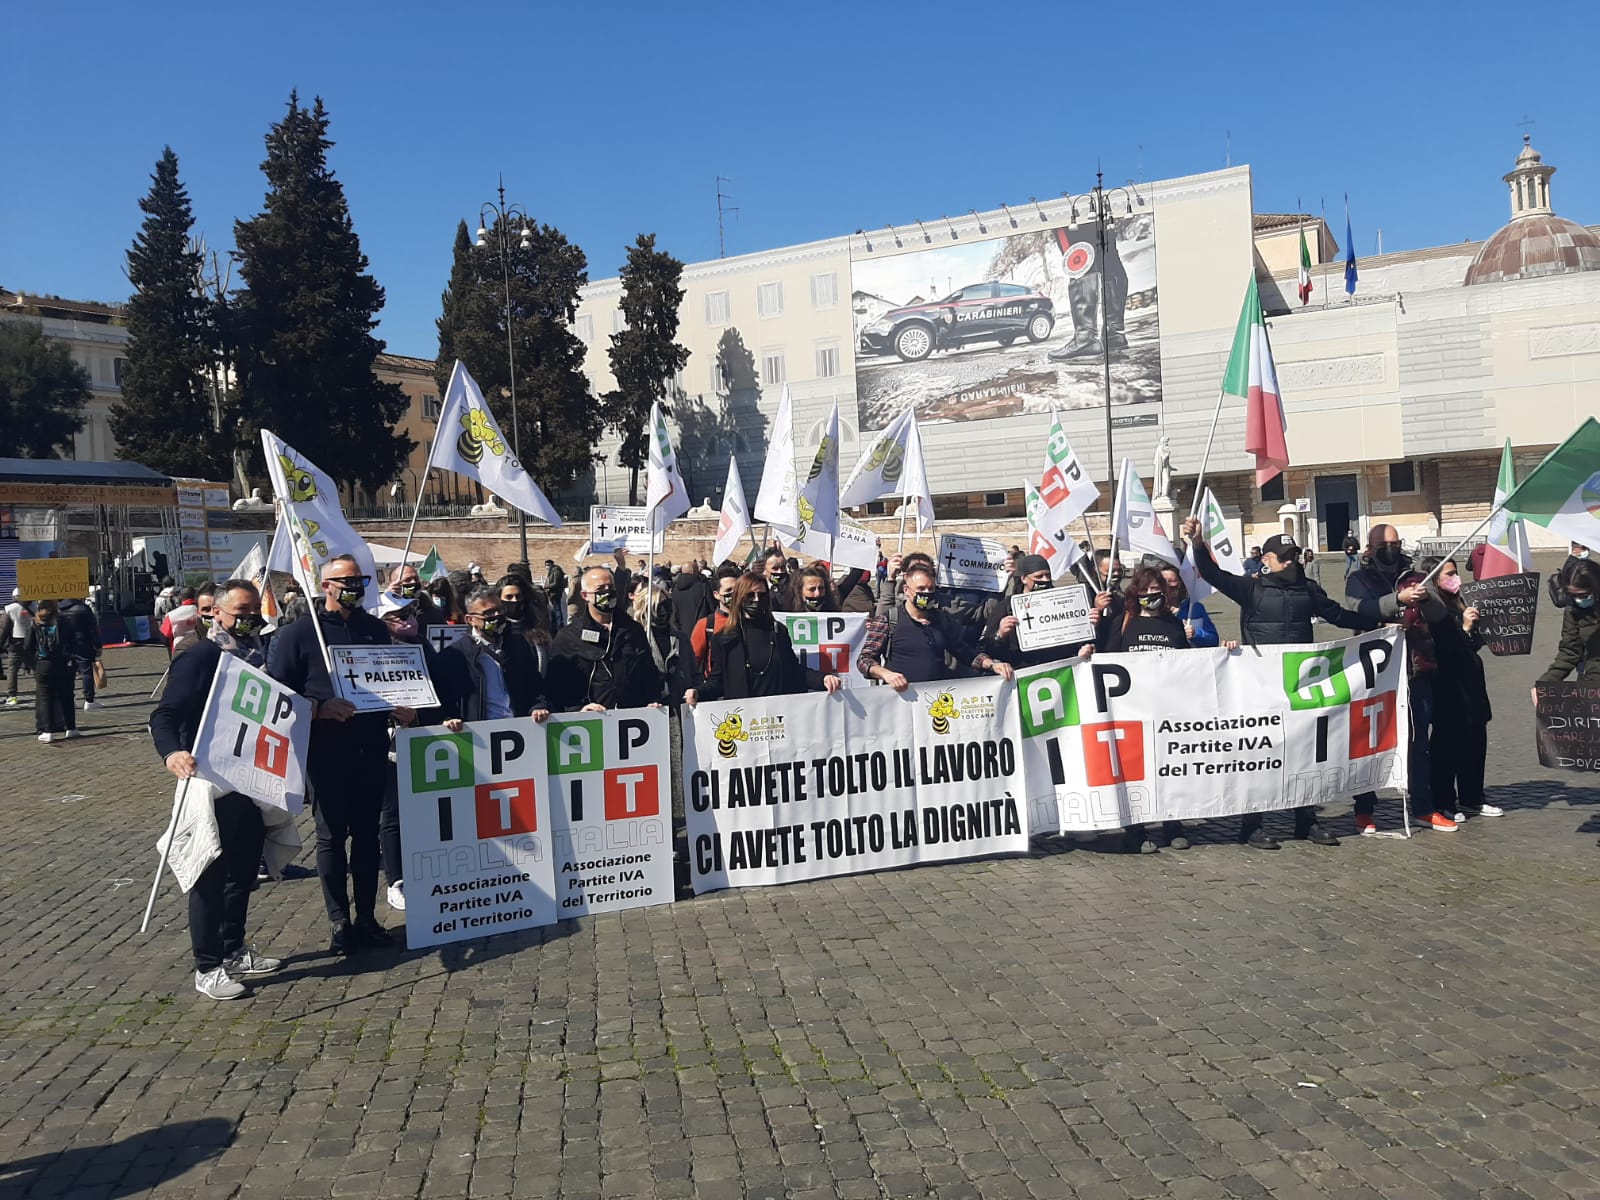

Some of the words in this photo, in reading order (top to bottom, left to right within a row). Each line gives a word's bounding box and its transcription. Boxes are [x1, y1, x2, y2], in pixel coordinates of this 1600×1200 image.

[956, 306, 1022, 322] CARABINIERI
[614, 525, 651, 535] IMPRES
[959, 559, 1006, 571] COMMERCIO
[1039, 609, 1087, 624] COMMERCIO
[1480, 608, 1505, 617] ENZA
[1138, 634, 1169, 642] NERVOSA
[364, 670, 424, 683] PALESTRE
[1158, 713, 1281, 734] Associazione
[750, 734, 785, 743] TOSCANA
[1167, 738, 1231, 755] Partite
[1238, 736, 1273, 751] IVA
[691, 769, 720, 812] CI
[728, 761, 807, 809] AVETE
[812, 751, 886, 798] TOLTO
[893, 747, 915, 788] IL
[919, 738, 1015, 785] LAVORO
[1158, 760, 1188, 778] del
[1195, 755, 1282, 776] Territorio
[695, 832, 722, 875] CI
[729, 824, 806, 870] AVETE
[811, 813, 885, 861] TOLTO
[890, 810, 918, 850] LA
[923, 792, 1021, 845] DIGNITÀ
[412, 836, 543, 880] ITALIA
[562, 852, 651, 873] Associazione
[431, 871, 530, 897] Associazione
[569, 874, 616, 889] Partite
[619, 869, 644, 883] IVA
[440, 897, 491, 914] Partite
[495, 889, 523, 904] IVA
[562, 895, 584, 908] del
[587, 885, 652, 905] Territorio
[432, 920, 457, 934] del
[460, 907, 533, 930] Territorio
